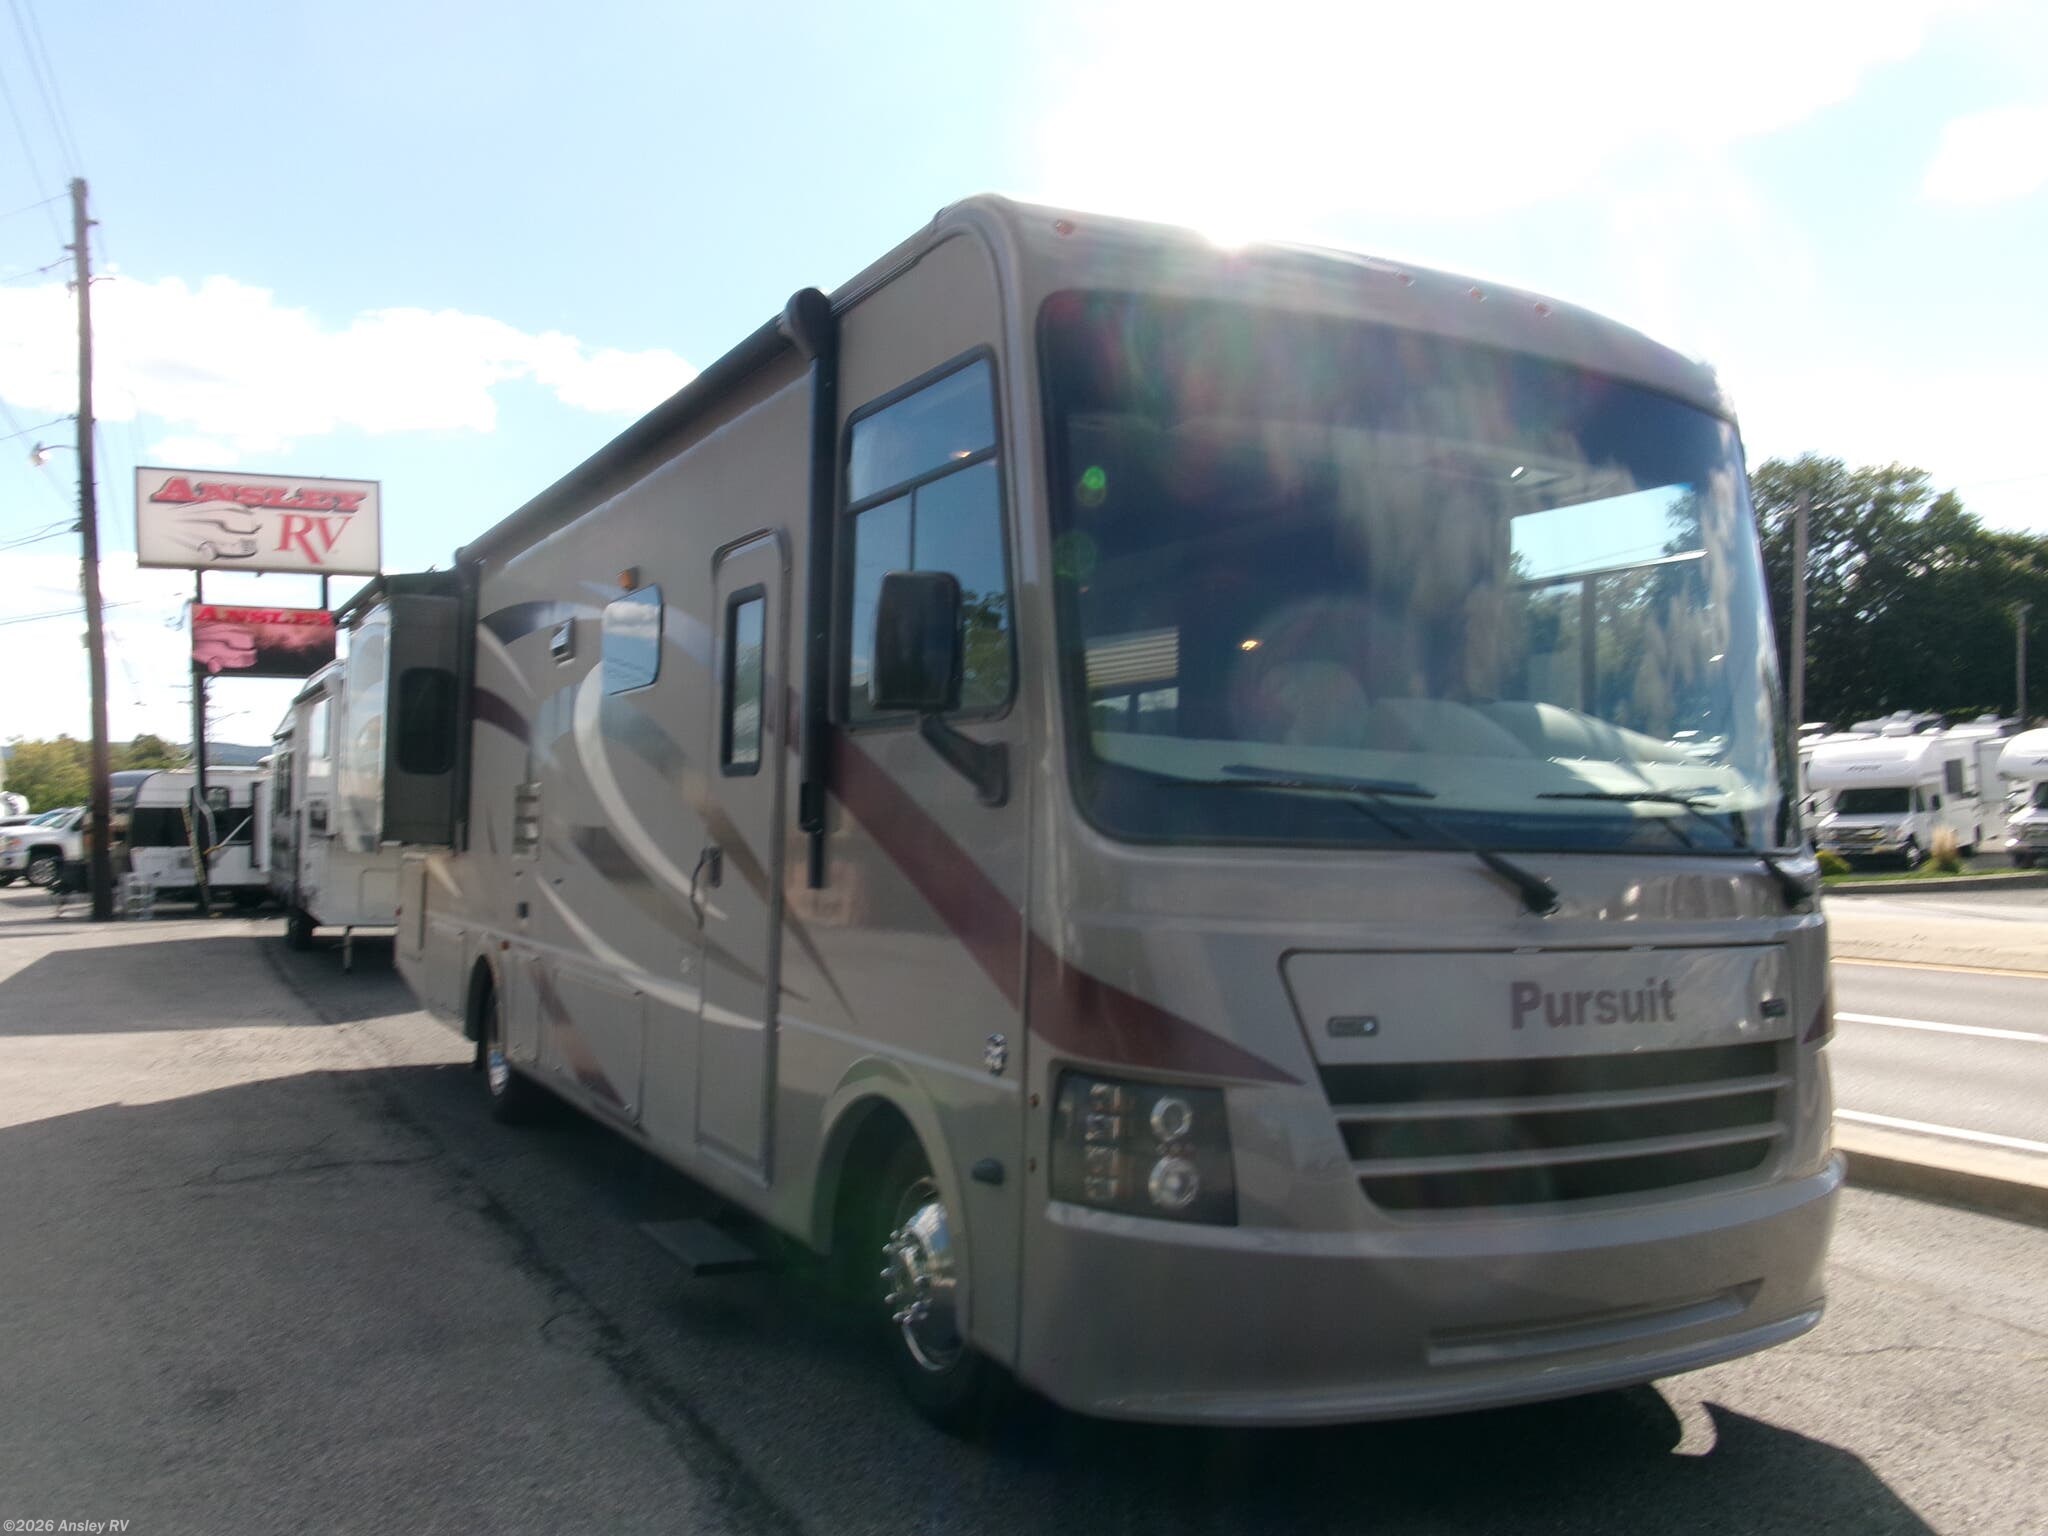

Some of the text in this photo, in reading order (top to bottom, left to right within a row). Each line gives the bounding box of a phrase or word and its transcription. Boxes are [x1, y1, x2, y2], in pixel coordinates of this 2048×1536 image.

[150, 476, 367, 513] ANSLEY
[273, 513, 352, 565] RV
[1510, 977, 1676, 1030] Pursuit
